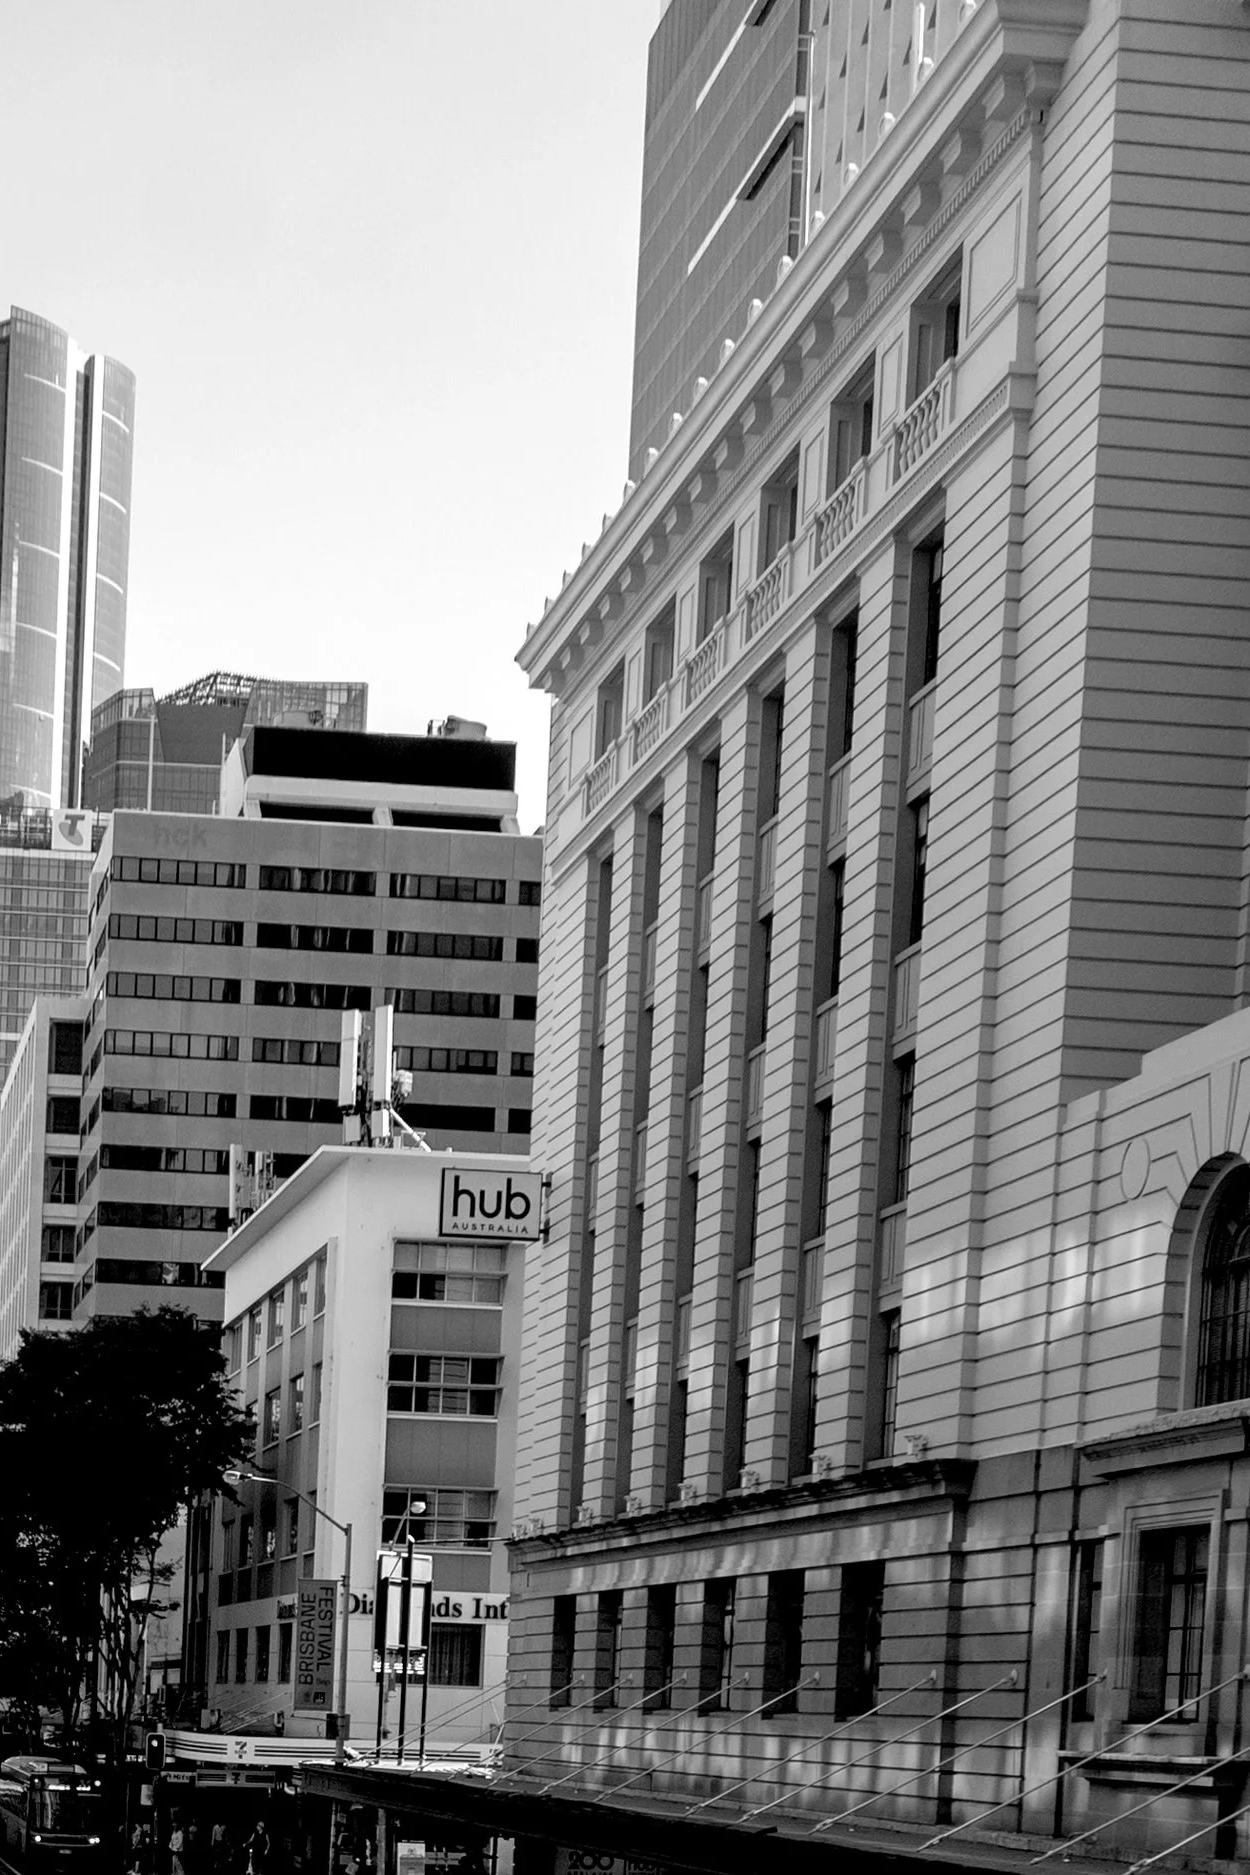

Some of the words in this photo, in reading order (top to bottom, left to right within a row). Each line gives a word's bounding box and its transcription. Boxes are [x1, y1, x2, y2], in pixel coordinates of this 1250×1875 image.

[452, 1222, 528, 1234] AUSTRALIA
[453, 1174, 530, 1219] hub
[298, 1593, 316, 1685] BRISBANE
[316, 1586, 334, 1672] FESTIVAL
